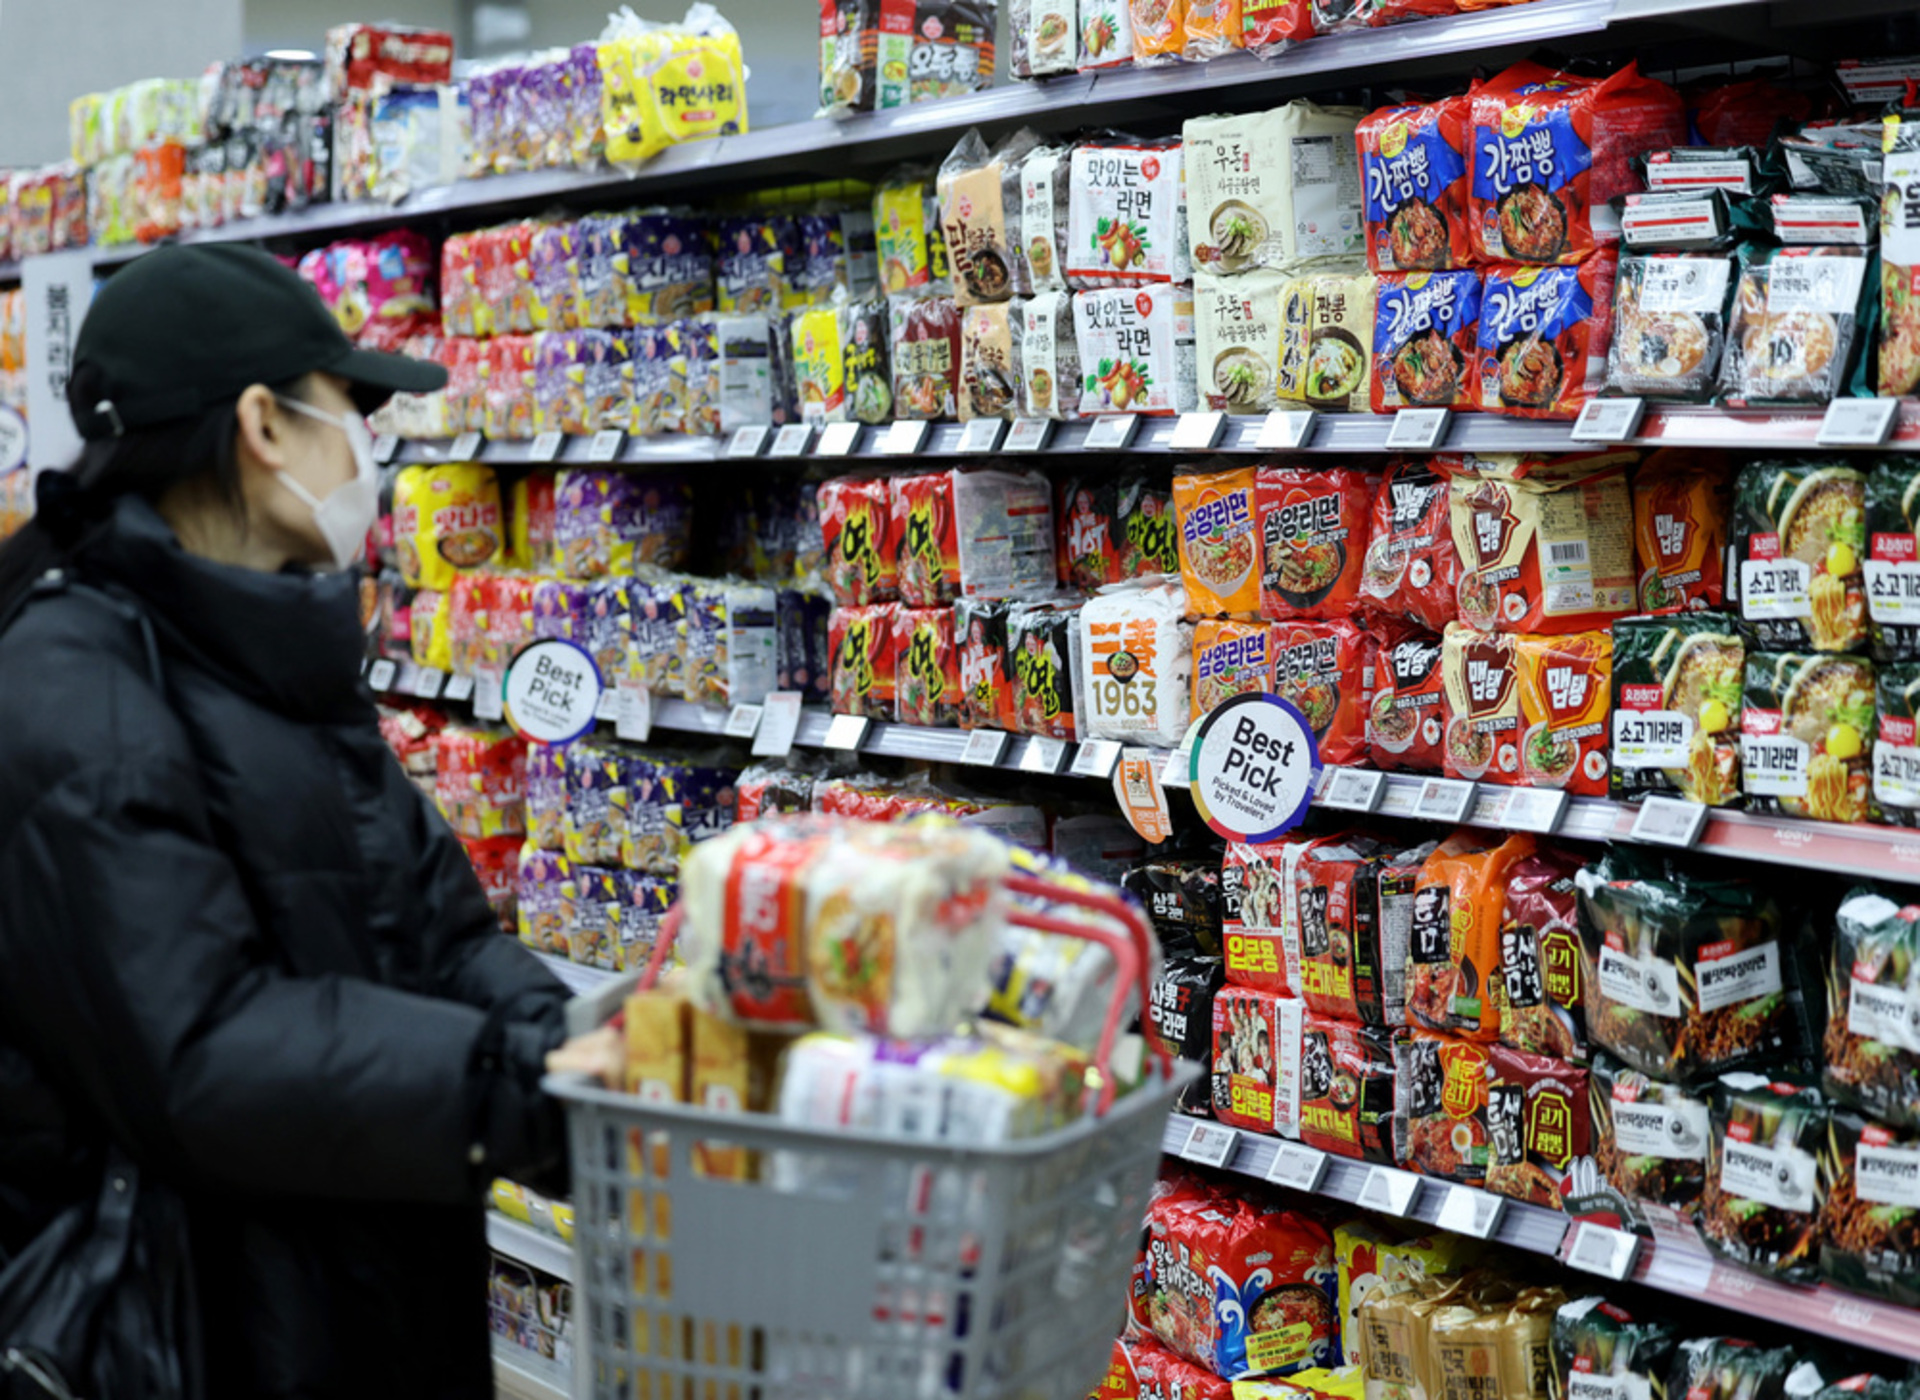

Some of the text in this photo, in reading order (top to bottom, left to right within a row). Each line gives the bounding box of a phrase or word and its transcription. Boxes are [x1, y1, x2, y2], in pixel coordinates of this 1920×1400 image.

[1088, 158, 1140, 188] 맛있는
[1369, 143, 1428, 213] 간짬뽕
[1483, 128, 1554, 195] 간짬뽕
[1117, 191, 1151, 219] 라면
[1086, 299, 1136, 328] 맛있는
[1316, 293, 1346, 324] 짬뽕
[1387, 275, 1456, 343] 간짬뽕
[1488, 279, 1562, 342] 간짬뽕
[1116, 327, 1150, 356] 라면
[1184, 489, 1249, 542] 삼양라면
[1264, 492, 1340, 546] 삼양라면
[1067, 517, 1107, 566] HOT
[1655, 514, 1686, 555] 맵탱
[535, 654, 583, 690] Best
[1198, 632, 1247, 679] 삼양라면
[1276, 637, 1338, 685] 삼양라면
[528, 677, 575, 712] Pick
[1092, 680, 1157, 717] 1963
[1468, 661, 1504, 700] 맵탱
[1547, 666, 1588, 709] 맵탱
[1232, 716, 1296, 767] Best
[1620, 721, 1683, 743] 소고기라면
[1222, 747, 1283, 798] Pick
[1212, 776, 1242, 797] Picked
[1249, 794, 1276, 813] Loved
[1214, 790, 1266, 821] by Travelers
[1228, 936, 1279, 973] 입문용
[1503, 932, 1542, 1000] 틈새라면
[1701, 953, 1766, 985] 불맛짜장라면
[1231, 1086, 1272, 1122] 입문용
[1446, 1080, 1472, 1106] 김치
[1488, 1091, 1522, 1158] 틈새라면
[1539, 1106, 1564, 1129] 고기
[1537, 1131, 1563, 1155] 짬뽕
